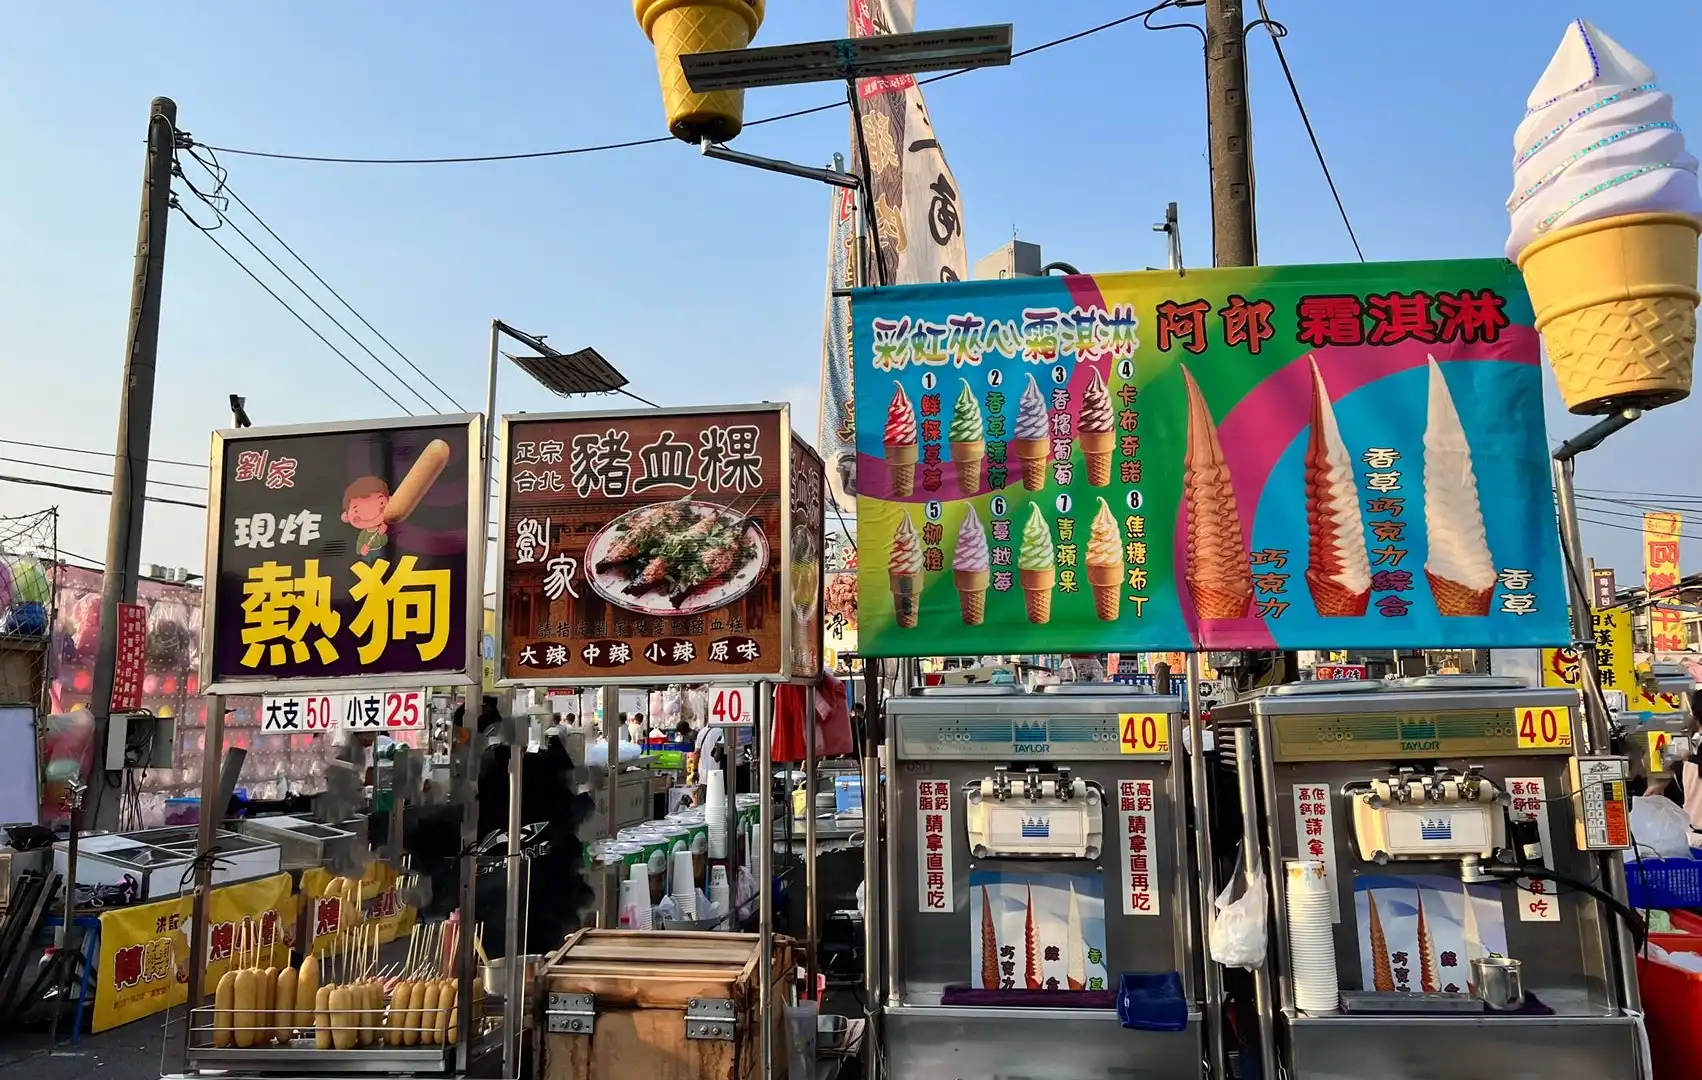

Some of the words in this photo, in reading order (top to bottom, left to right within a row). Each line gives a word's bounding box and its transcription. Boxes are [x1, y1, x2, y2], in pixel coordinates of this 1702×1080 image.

[873, 304, 1140, 371] 彩虹夾心霜淇淋
[1156, 295, 1275, 355] 阿郎
[1296, 287, 1511, 347] 霜淇淋
[513, 440, 564, 465] 正宗
[571, 425, 763, 498] 豬血粿
[986, 391, 1007, 490] 香草薄荷
[1052, 388, 1073, 485] 香檳葡萄
[1117, 383, 1141, 484] 卡布奇諾
[235, 449, 298, 489] 劉家
[513, 470, 565, 493] 台北
[234, 508, 322, 549] 現炸
[515, 516, 580, 601] 劉家
[991, 520, 1013, 591] 蔓越莓
[1057, 518, 1078, 594] 青蘋果
[1126, 514, 1149, 617] 焦糖布丁
[1250, 548, 1290, 619] 巧克力
[1497, 568, 1537, 616] 香草
[240, 555, 451, 668] 熱狗
[519, 643, 569, 666] 大辣
[583, 642, 632, 665] 中辣
[644, 641, 696, 662] 小辣
[708, 639, 761, 661] 原味
[265, 698, 299, 729] 大支
[346, 695, 380, 727] 小支
[1121, 716, 1168, 752] 40元
[1519, 708, 1571, 746] 40元
[1013, 744, 1050, 753] TAYLOR
[1400, 741, 1440, 751] TAYLOR
[919, 782, 933, 811] 低脂
[1120, 782, 1135, 812] 低脂
[925, 815, 946, 909] 請拿直再吃
[1127, 816, 1151, 911] 請拿直再吃
